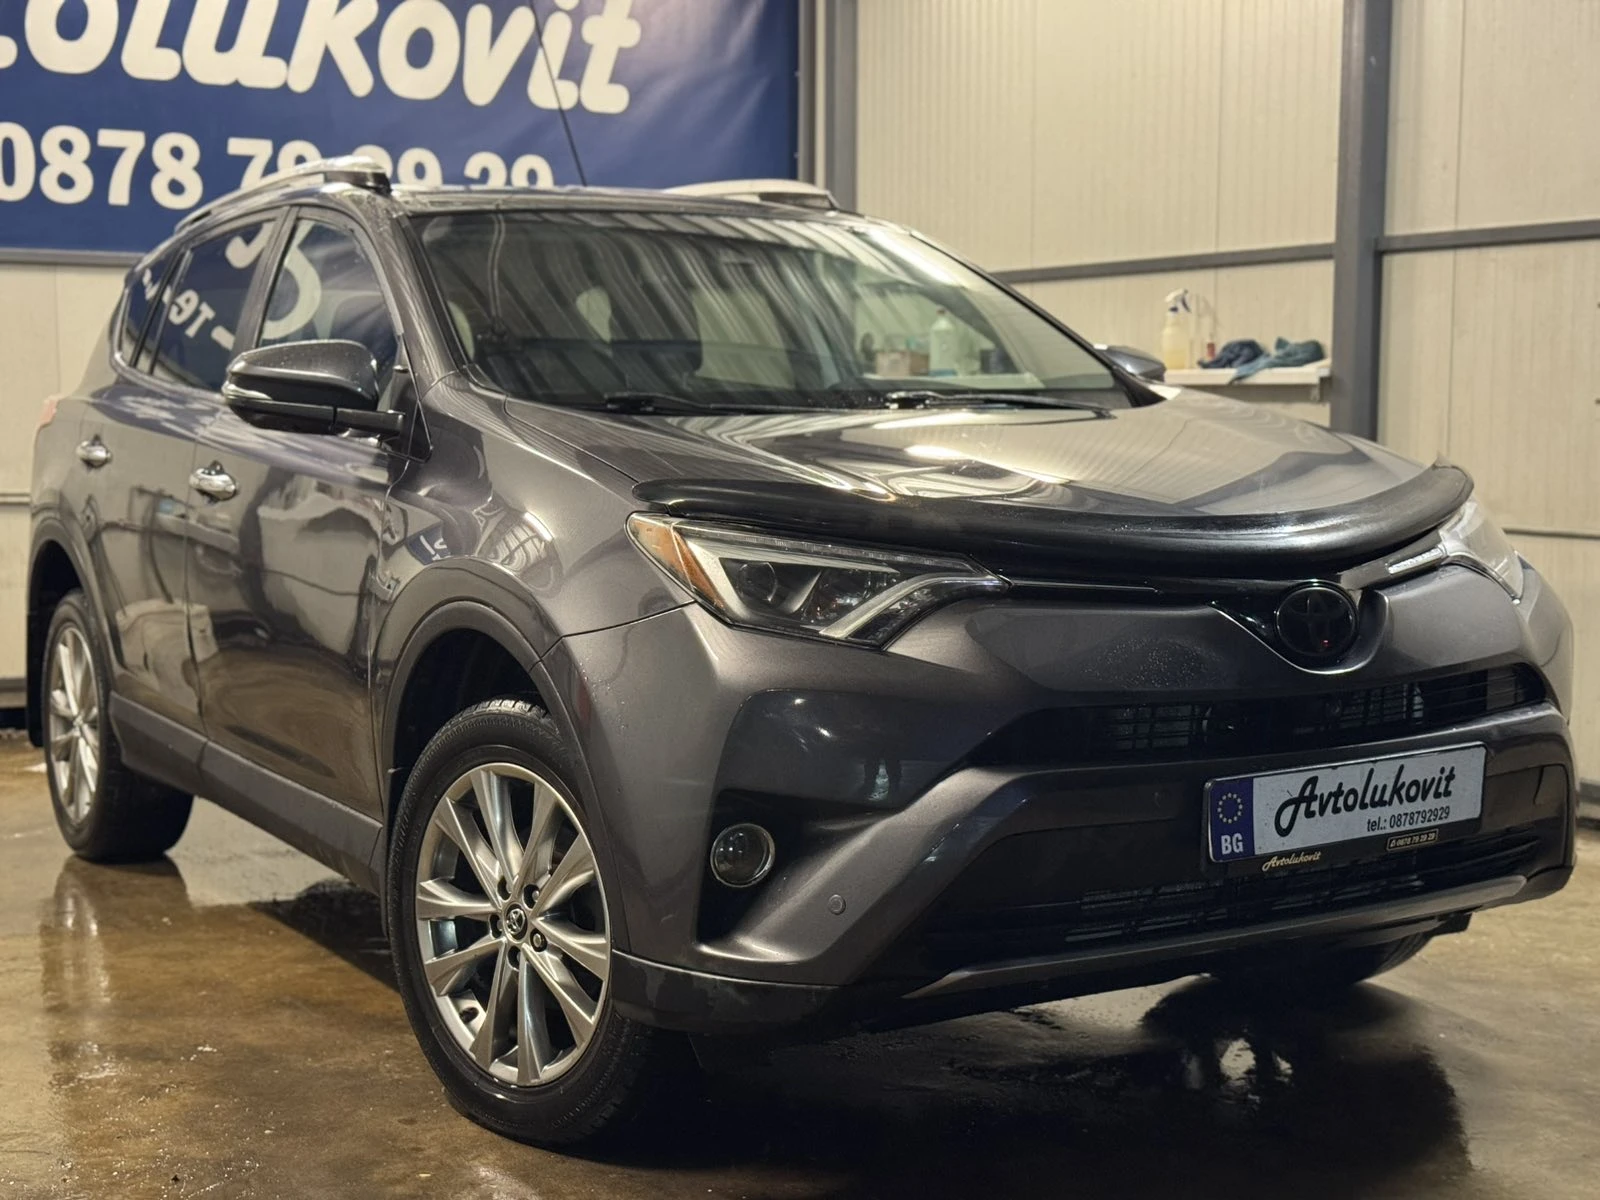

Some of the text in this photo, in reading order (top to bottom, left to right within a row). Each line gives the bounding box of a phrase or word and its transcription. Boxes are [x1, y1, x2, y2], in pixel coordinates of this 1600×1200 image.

[0, 0, 641, 114] olukovit
[0, 121, 203, 210] 0878
[1274, 763, 1456, 837] Avtolukovit
[1366, 806, 1450, 832] tel.: 0878792929
[1221, 832, 1244, 855] BG
[1261, 851, 1322, 872] Avtolukovit
